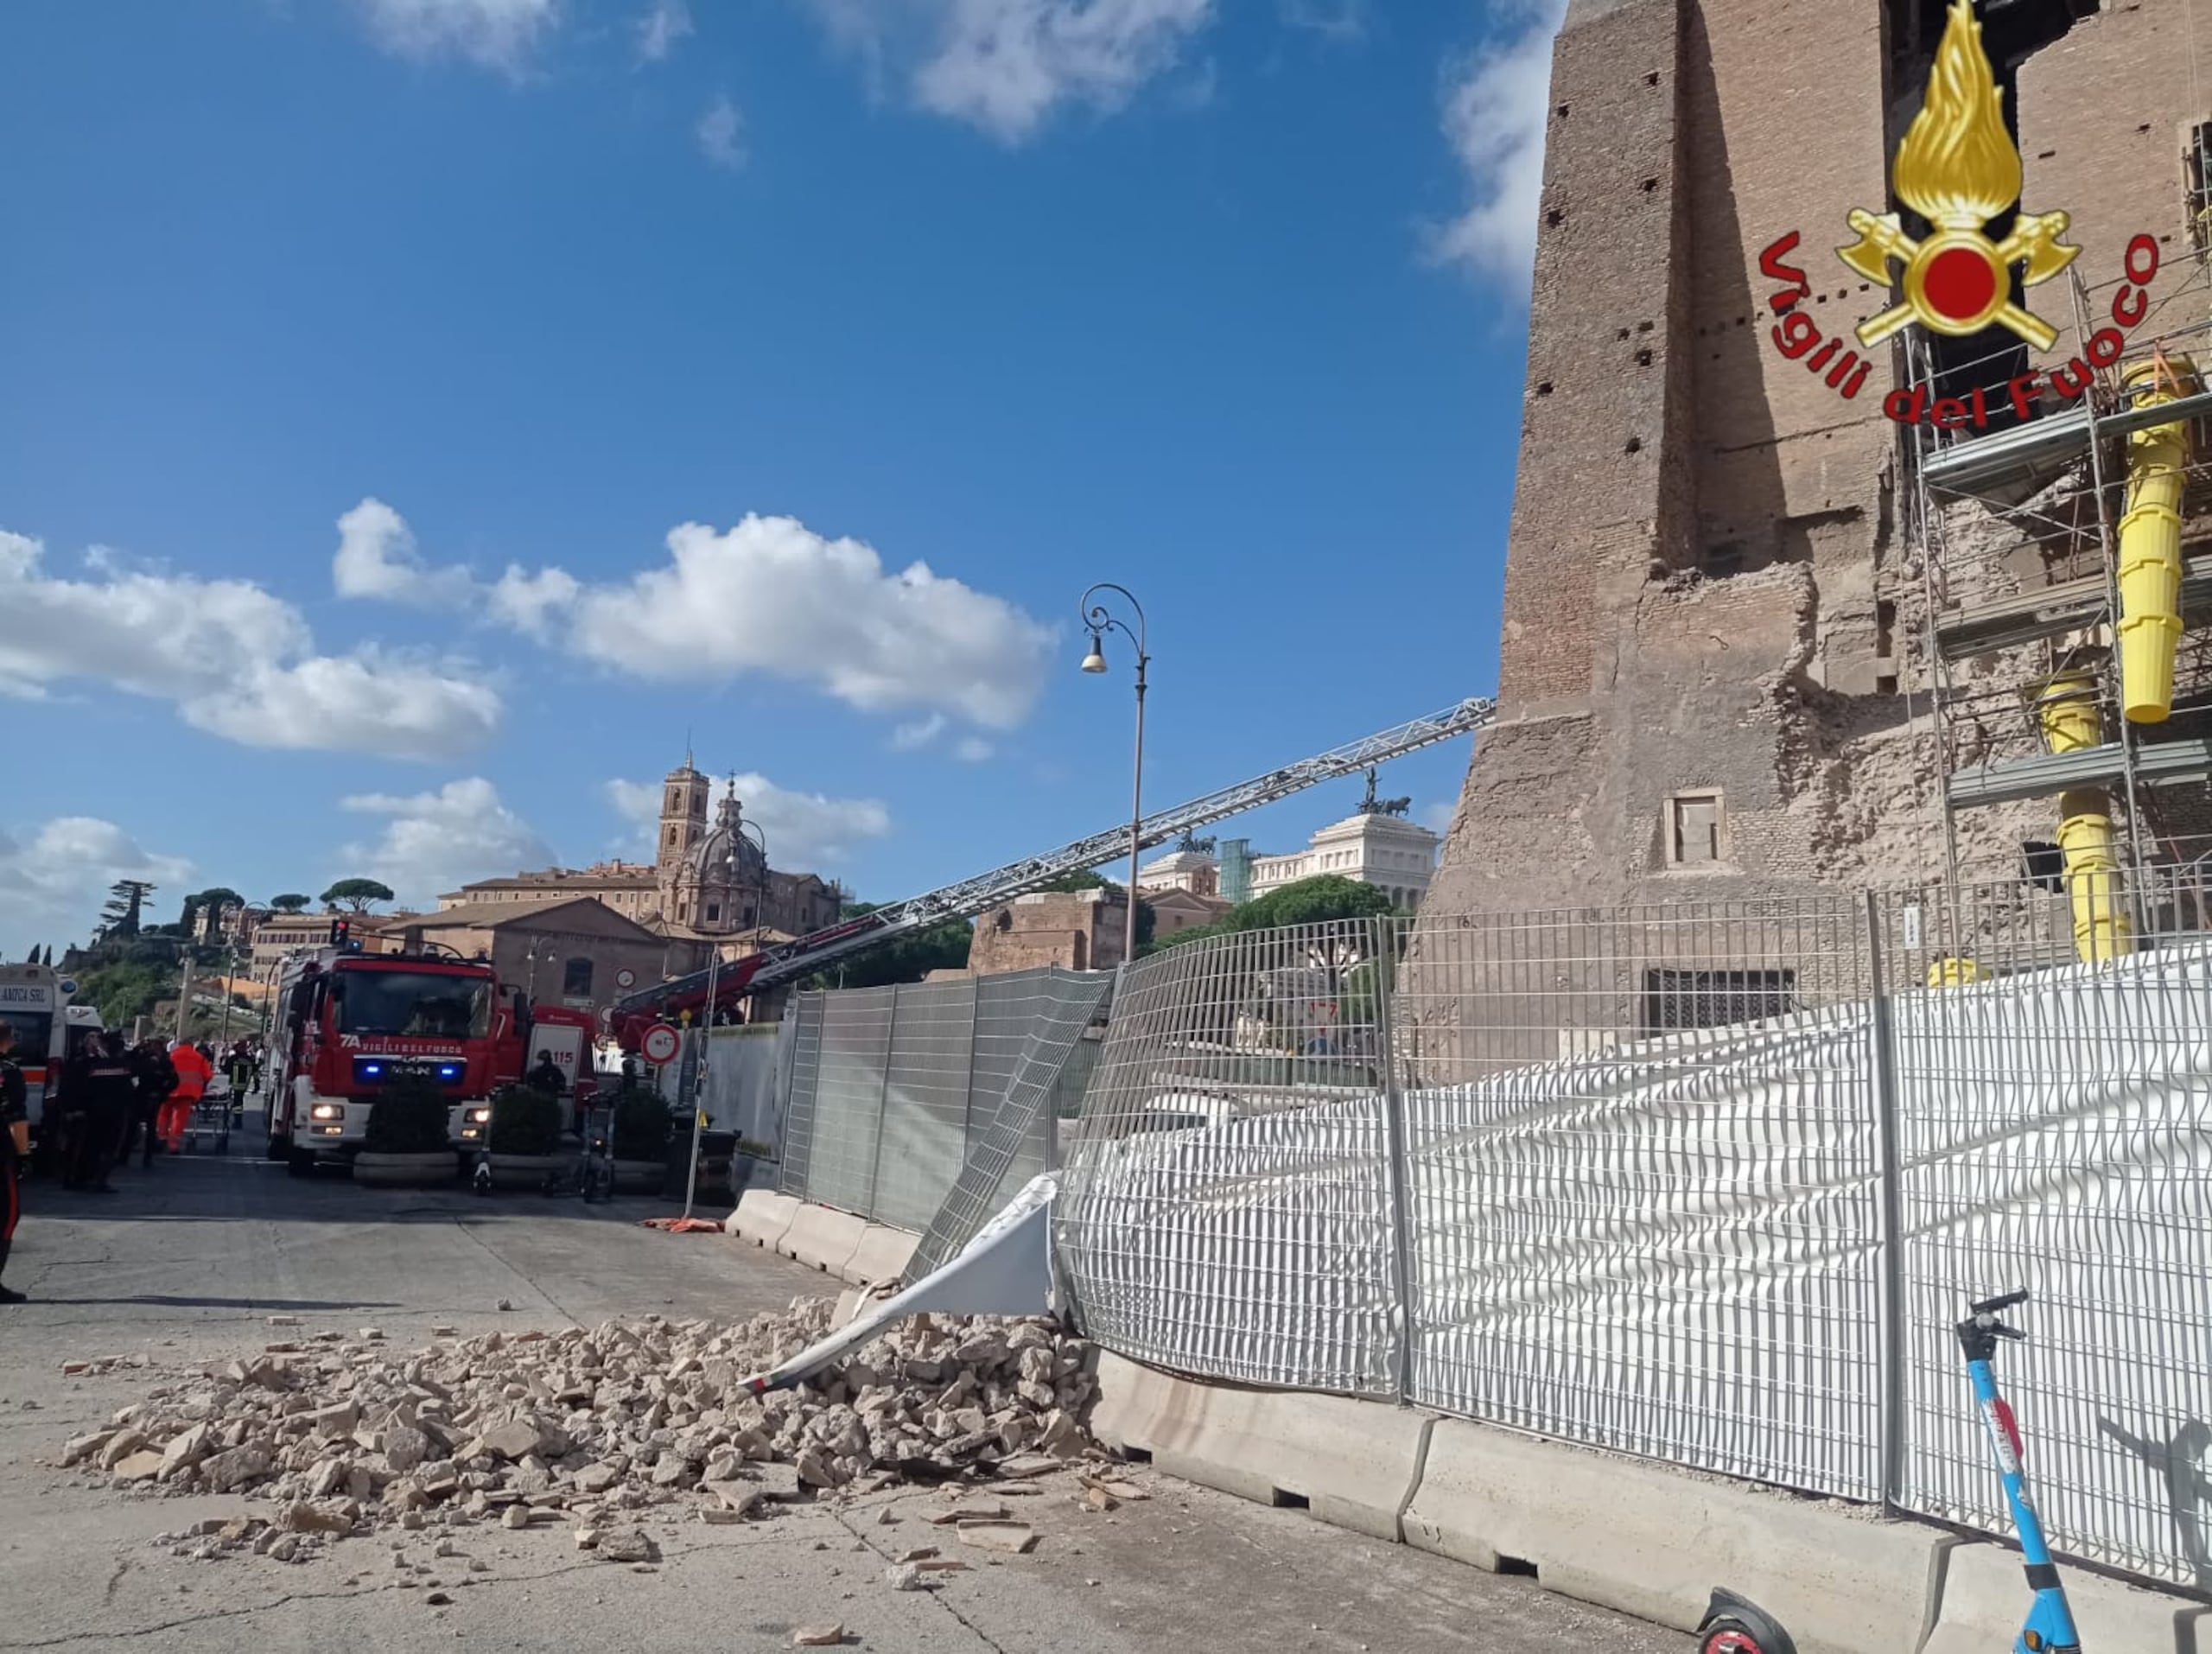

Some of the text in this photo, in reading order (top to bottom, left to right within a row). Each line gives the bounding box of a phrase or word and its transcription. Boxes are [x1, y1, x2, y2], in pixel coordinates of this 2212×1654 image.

[29, 989, 45, 1002] SRL
[340, 1034, 361, 1047] 7A
[554, 1051, 573, 1063] 115
